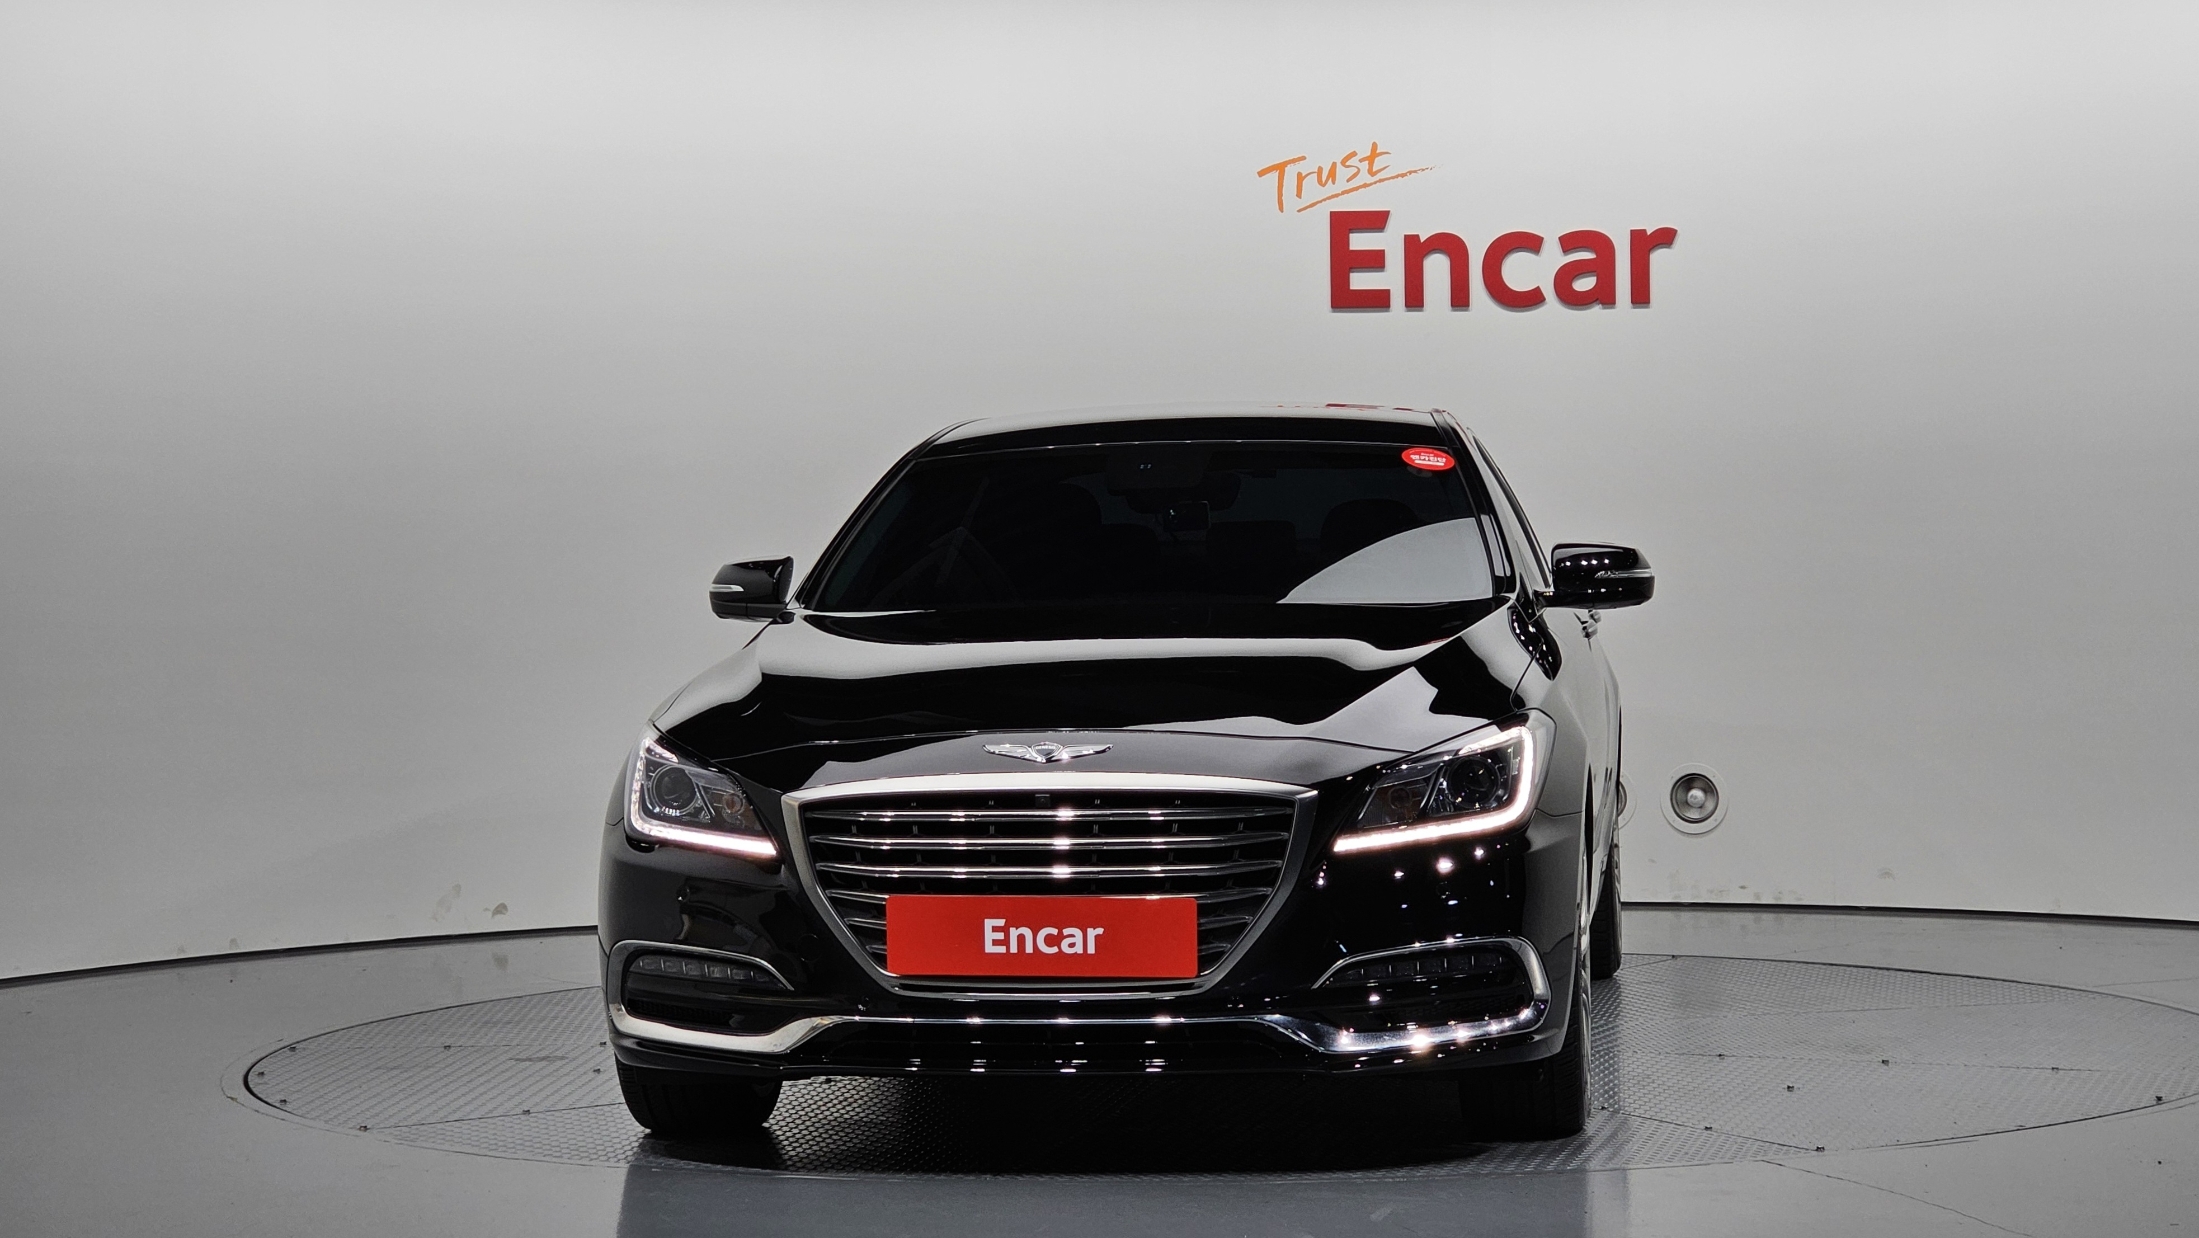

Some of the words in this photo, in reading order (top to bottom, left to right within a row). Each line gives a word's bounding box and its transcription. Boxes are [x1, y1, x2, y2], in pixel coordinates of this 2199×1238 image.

[1257, 141, 1392, 213] Trust
[1329, 210, 1678, 309] Encar
[984, 918, 1104, 954] Encar
